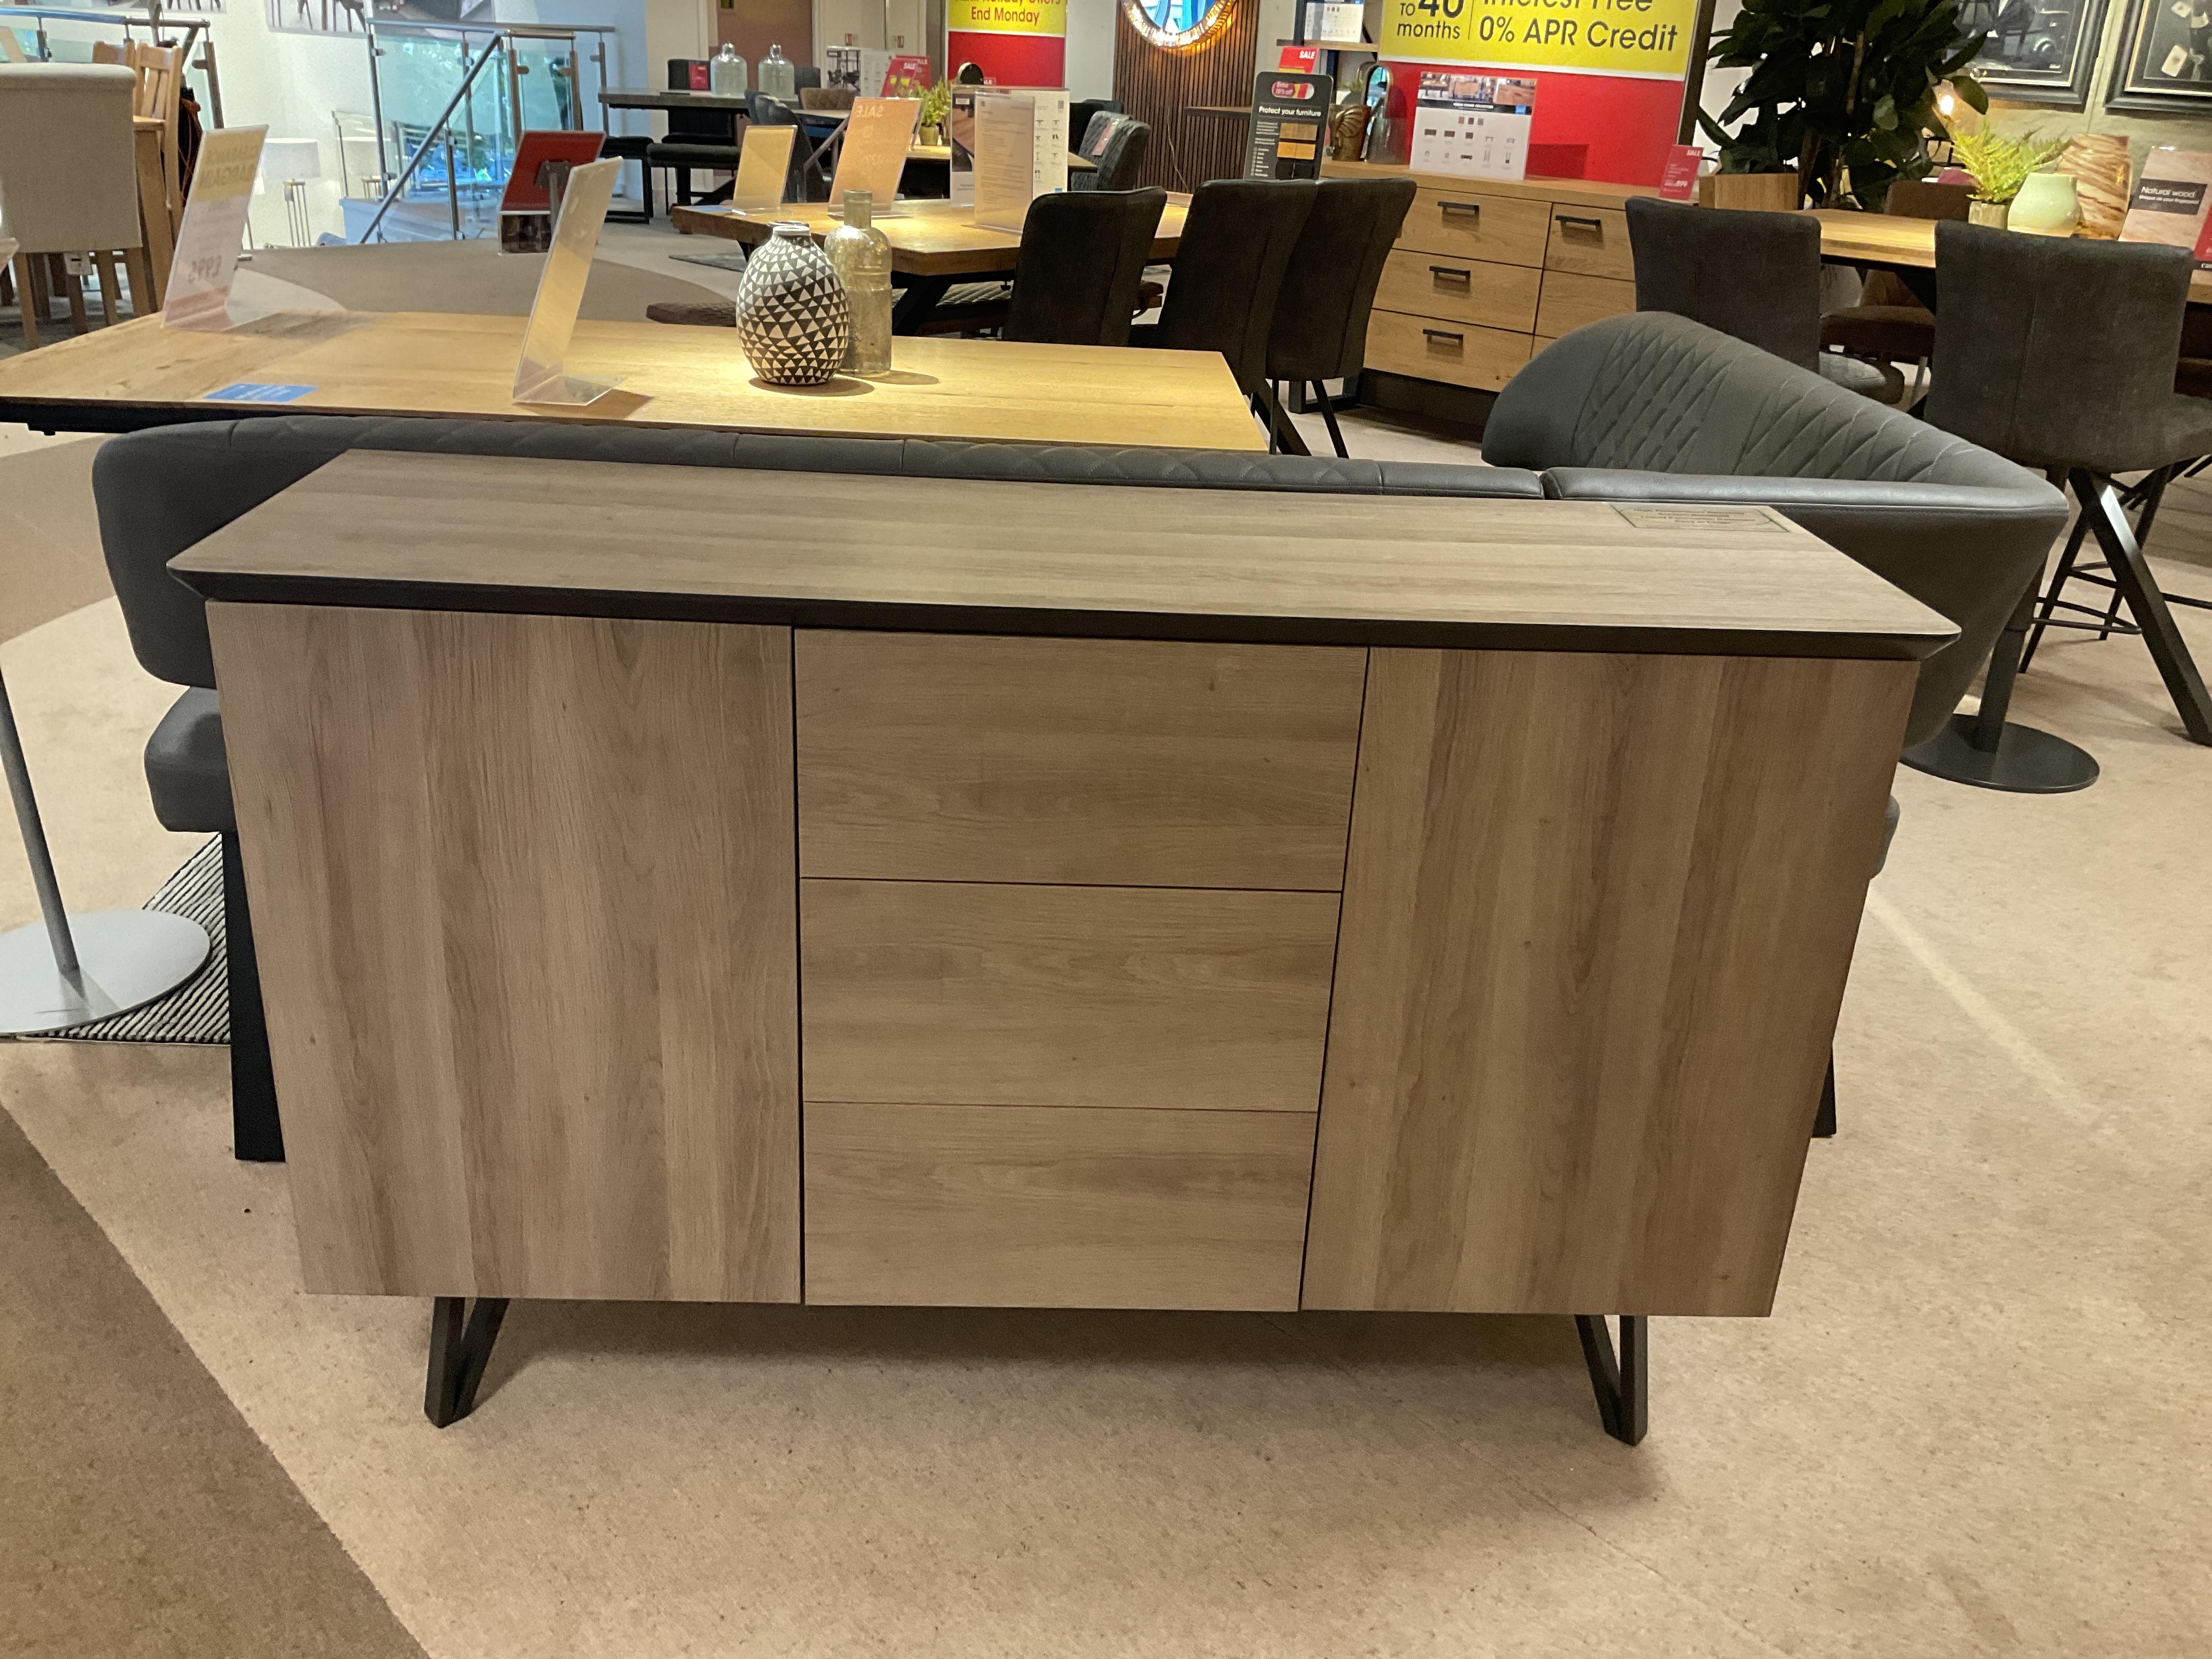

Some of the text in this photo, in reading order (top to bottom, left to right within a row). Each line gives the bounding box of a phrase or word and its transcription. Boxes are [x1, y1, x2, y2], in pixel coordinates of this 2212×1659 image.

[1400, 3, 1415, 16] TO
[971, 7, 1040, 26] End Monday
[1397, 21, 1460, 39] months
[1480, 15, 1678, 52] 0% APR Credit
[1299, 50, 1316, 59] SALE
[1259, 106, 1280, 114] Protect
[1296, 109, 1322, 117] furniture
[2141, 186, 2172, 195] Natural
